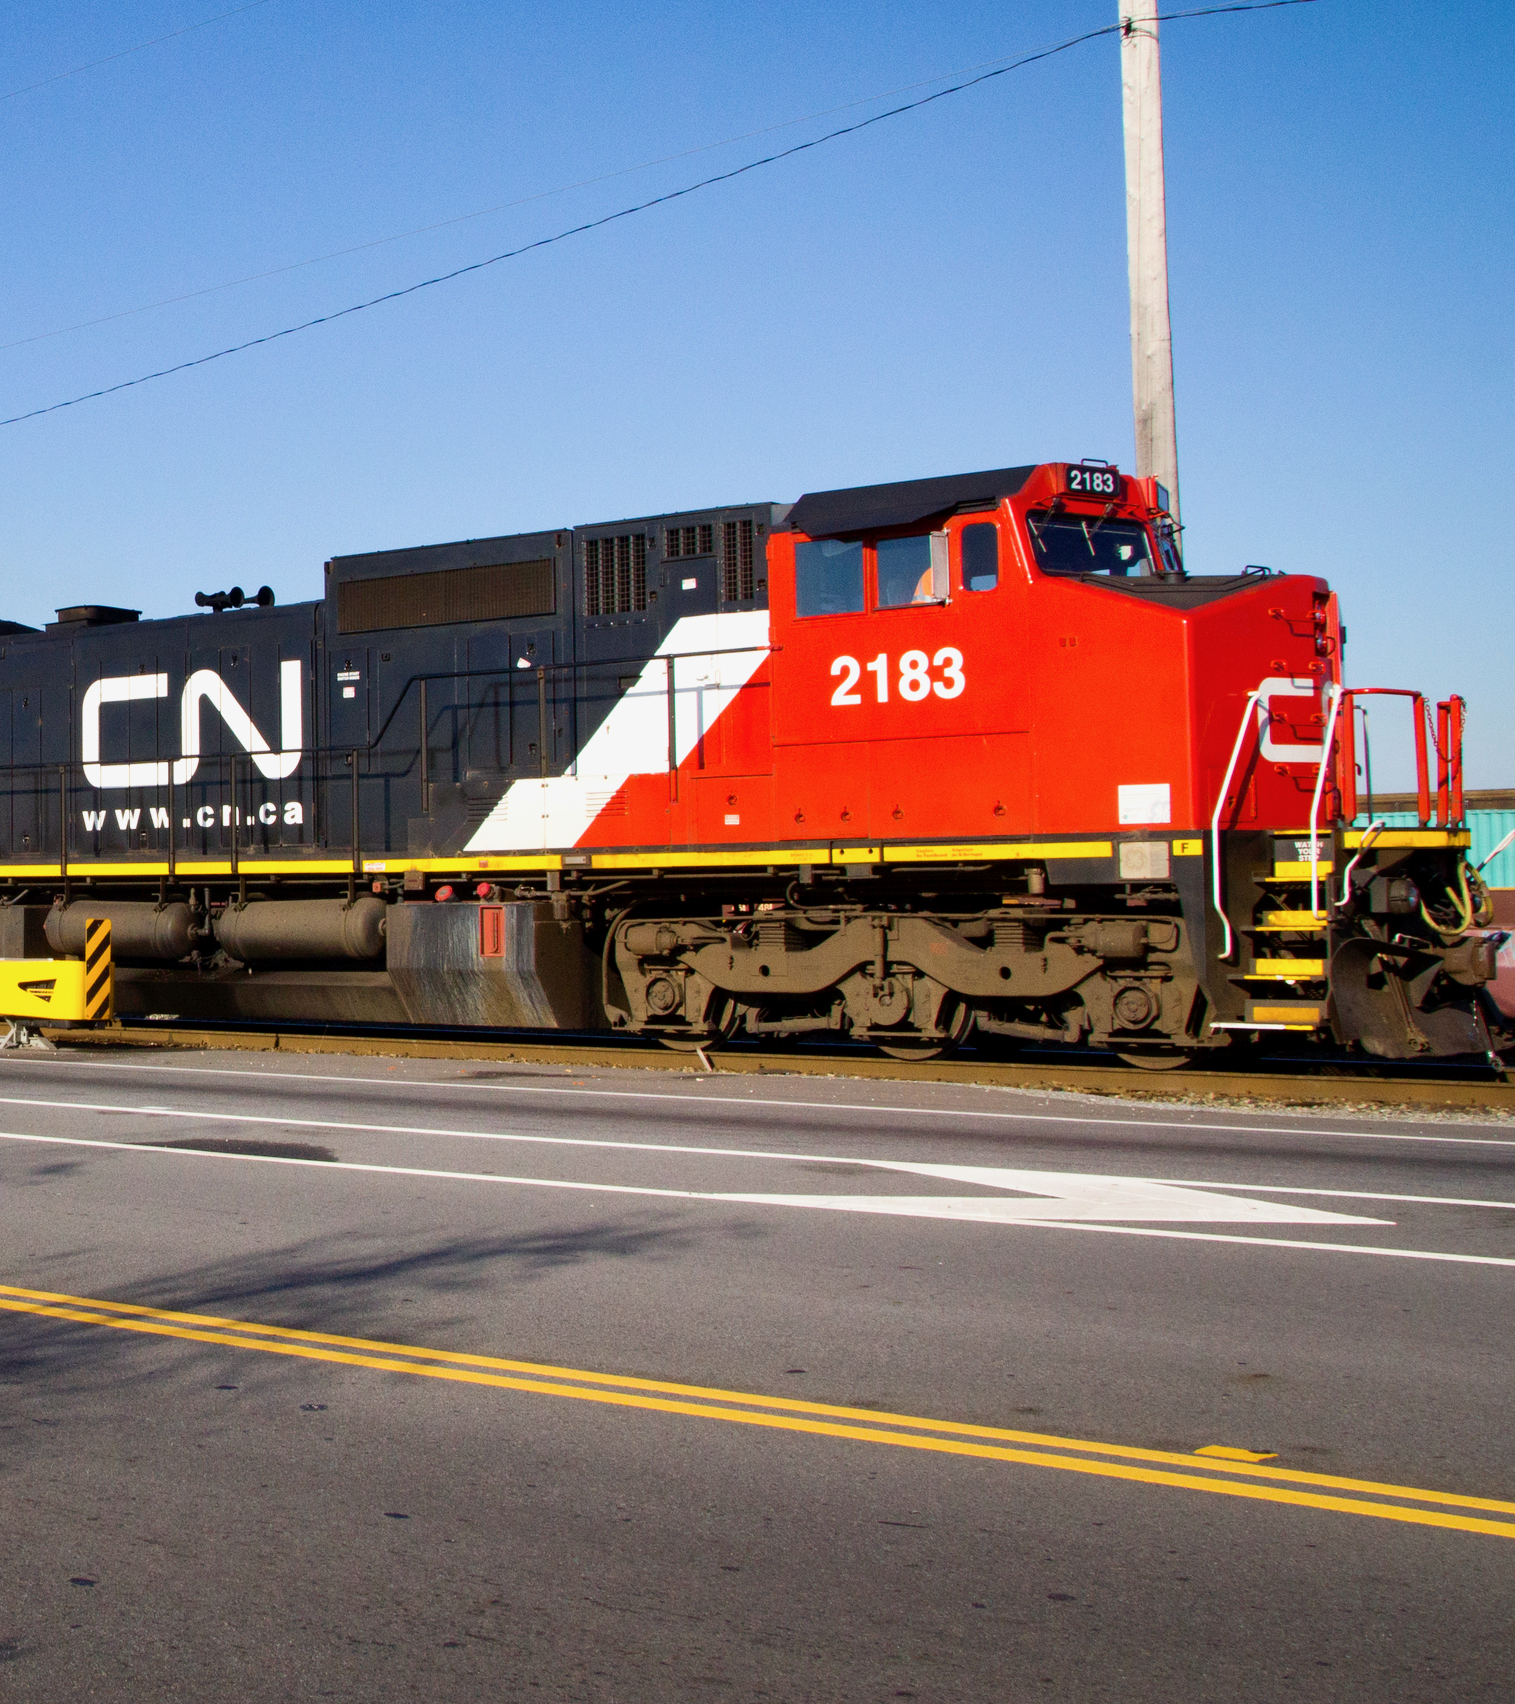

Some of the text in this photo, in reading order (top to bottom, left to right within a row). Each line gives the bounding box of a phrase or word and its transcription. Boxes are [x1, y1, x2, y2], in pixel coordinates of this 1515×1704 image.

[1070, 469, 1115, 493] 2183
[829, 647, 966, 706] 2183
[81, 659, 303, 789] CN
[82, 801, 303, 832] www.cn.ca
[1181, 842, 1189, 854] F
